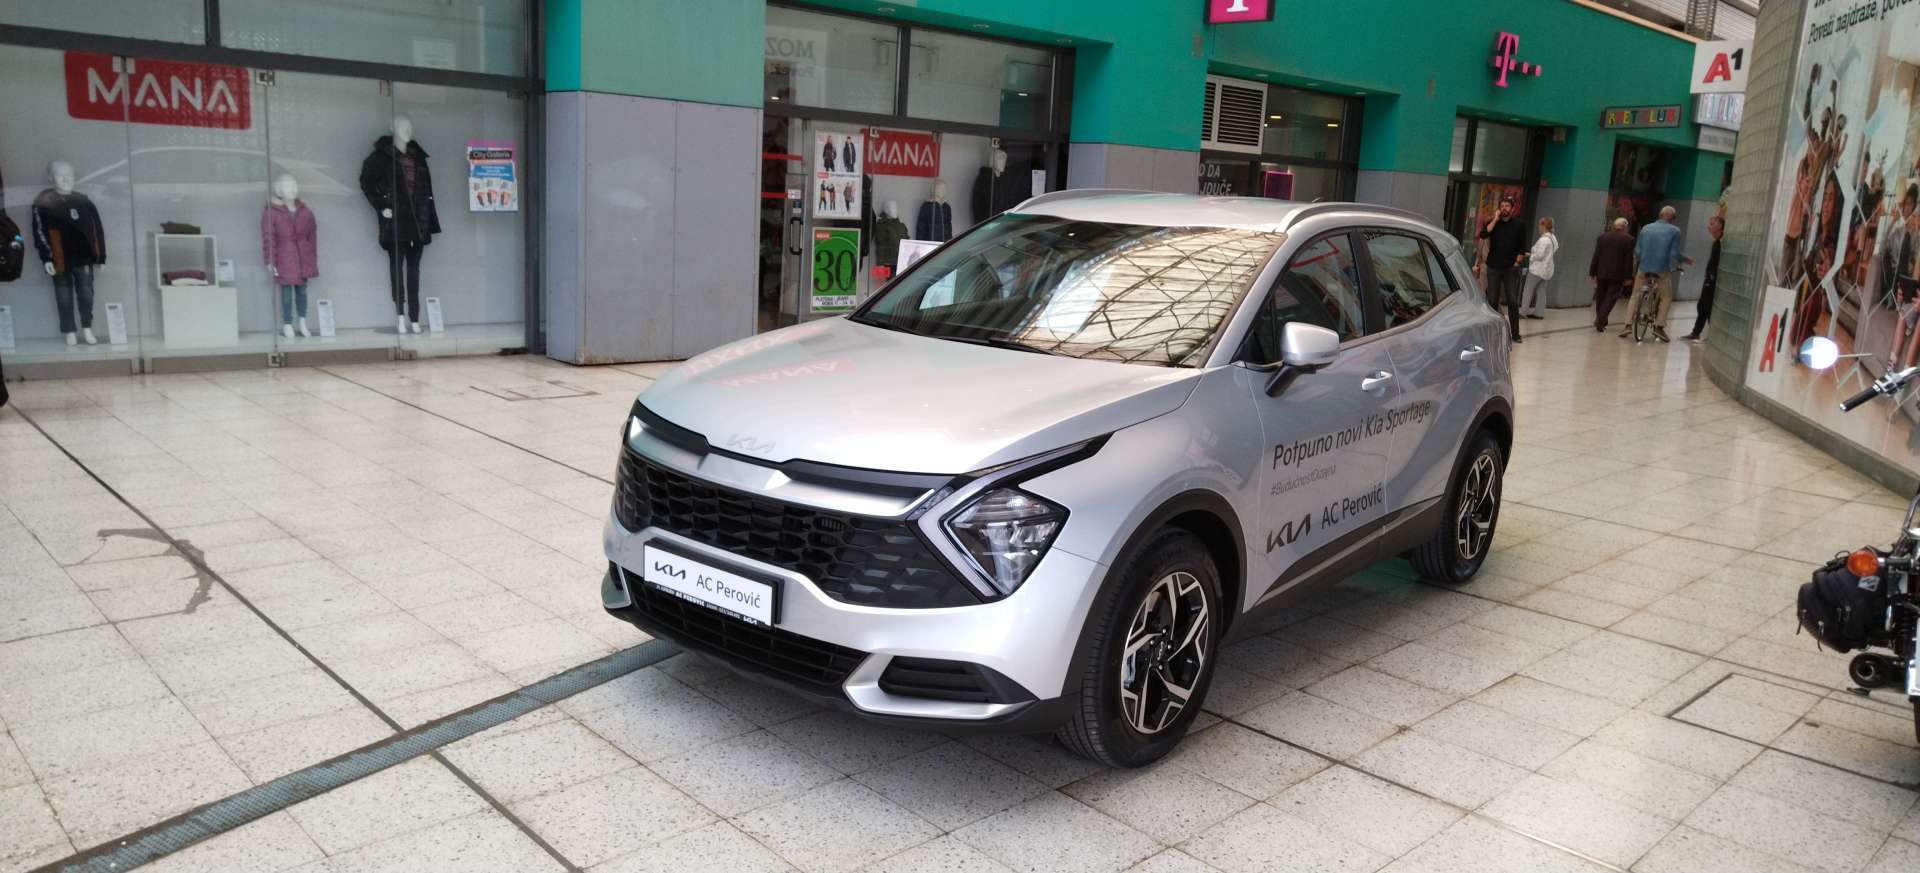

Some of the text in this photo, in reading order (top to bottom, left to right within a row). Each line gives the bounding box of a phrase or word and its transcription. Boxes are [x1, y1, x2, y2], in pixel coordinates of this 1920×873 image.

[1702, 47, 1744, 84] A1
[87, 67, 239, 113] MANA
[867, 140, 935, 168] MANA
[1207, 164, 1221, 178] DA
[813, 249, 857, 292] 30
[1759, 307, 1789, 373] A1
[1273, 400, 1431, 470] Potpuno novi Kia Sportage
[1266, 482, 1382, 554] KIA AC Perović
[655, 561, 686, 580] KIA
[697, 574, 713, 592] AC
[716, 580, 761, 608] Perović
